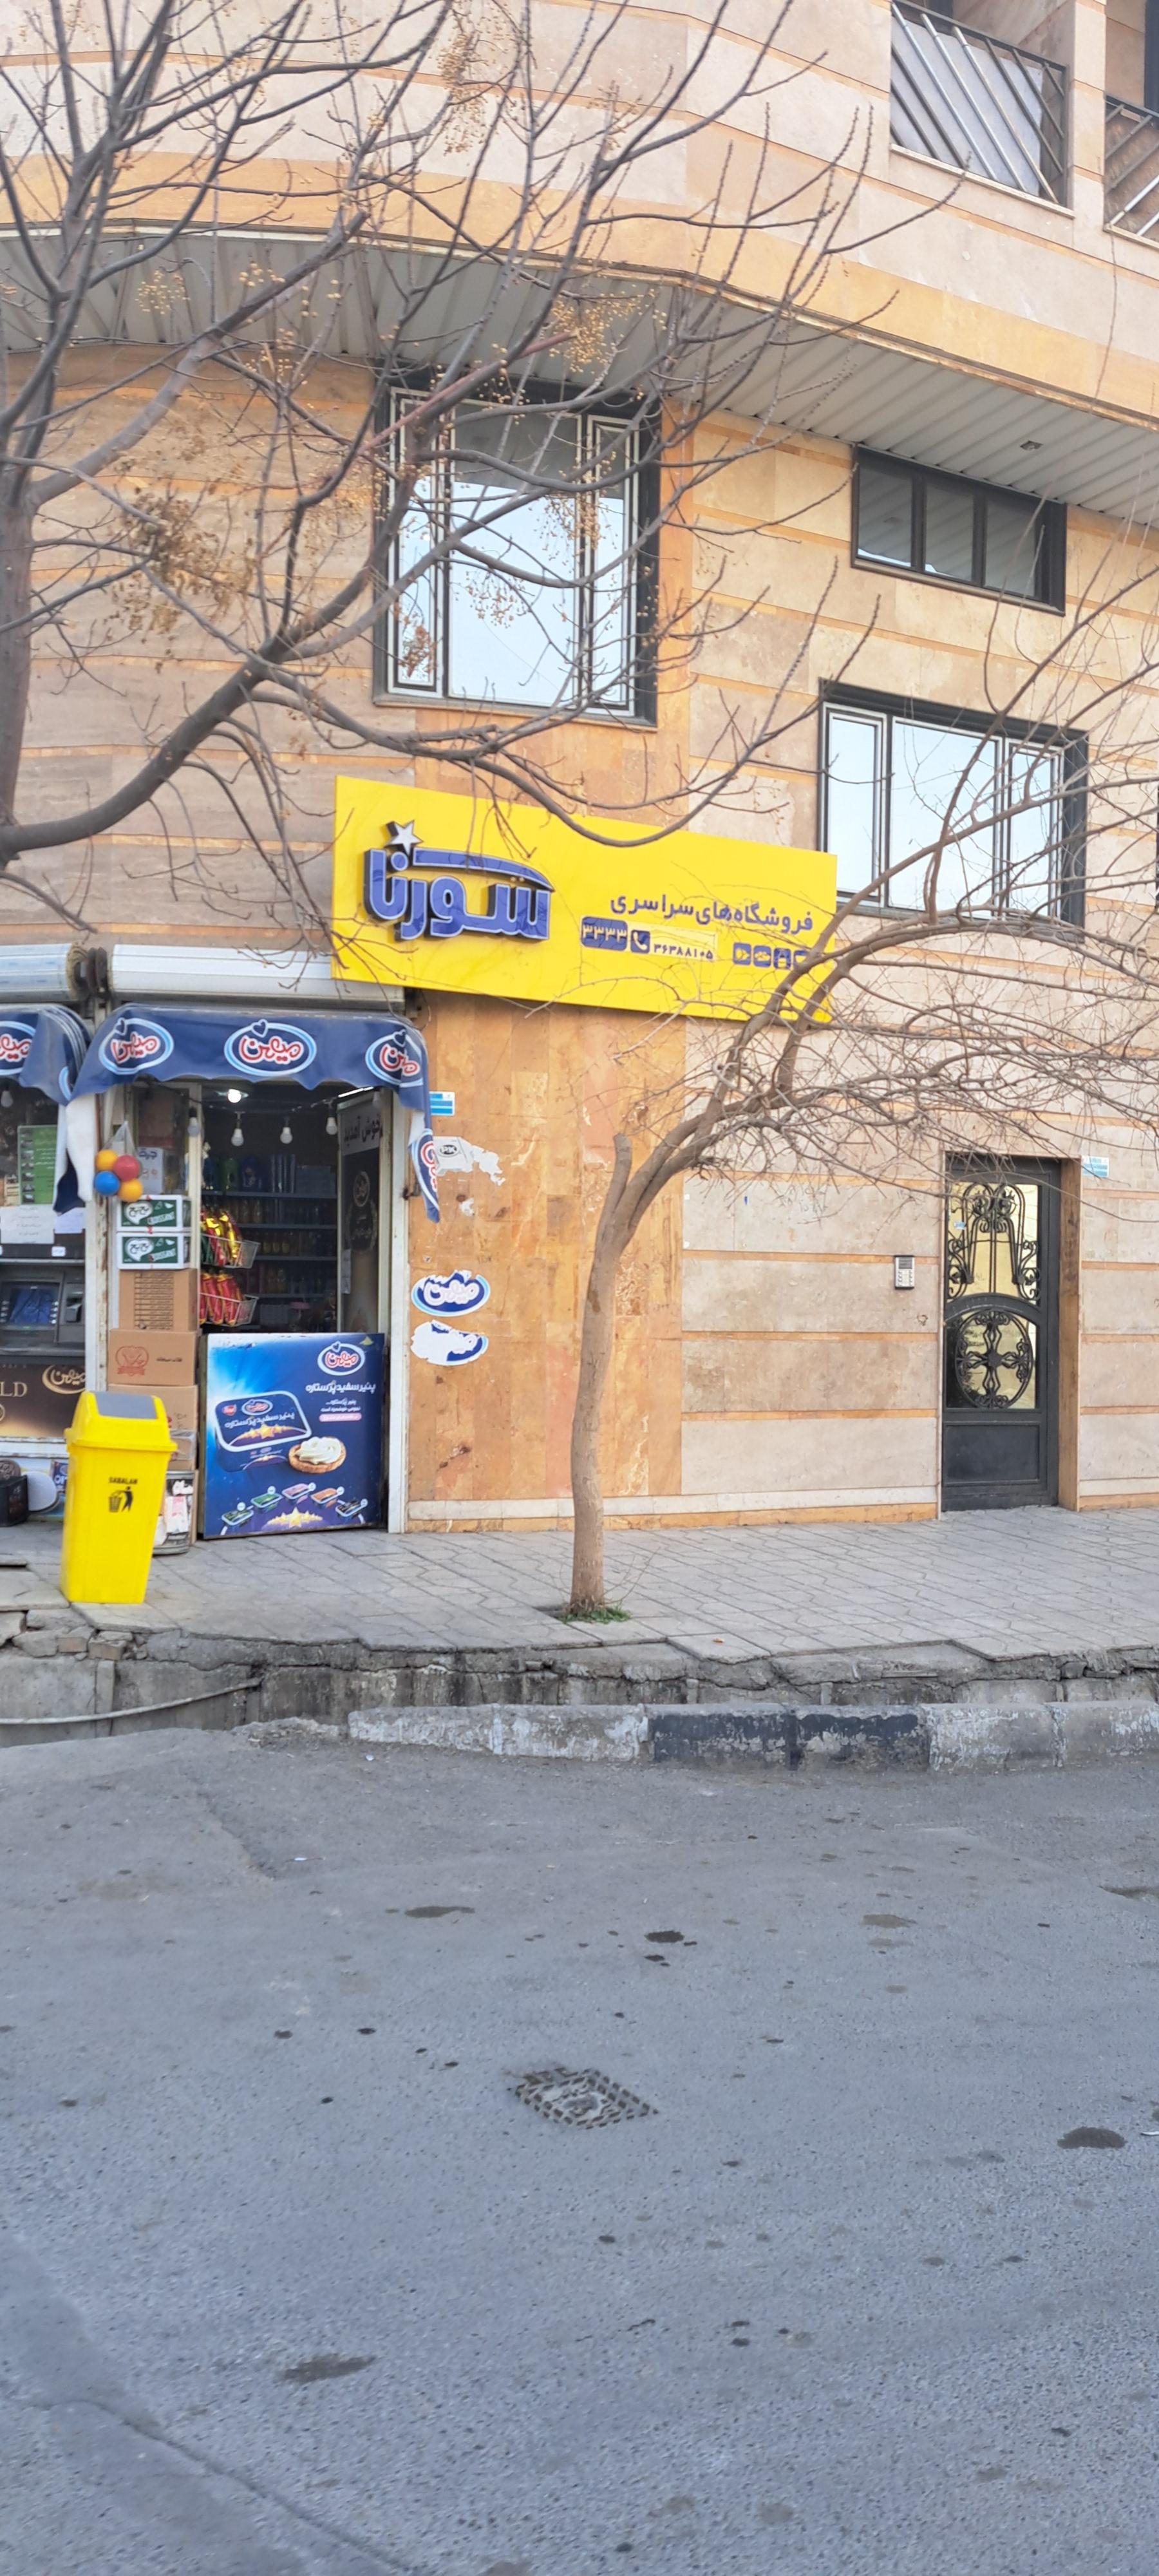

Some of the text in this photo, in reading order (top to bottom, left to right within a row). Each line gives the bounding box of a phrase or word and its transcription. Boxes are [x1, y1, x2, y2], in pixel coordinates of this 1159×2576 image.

[364, 846, 555, 940] سورنا
[610, 894, 694, 920] سراسری
[239, 1036, 304, 1064] میهن
[325, 1351, 359, 1368] میهن
